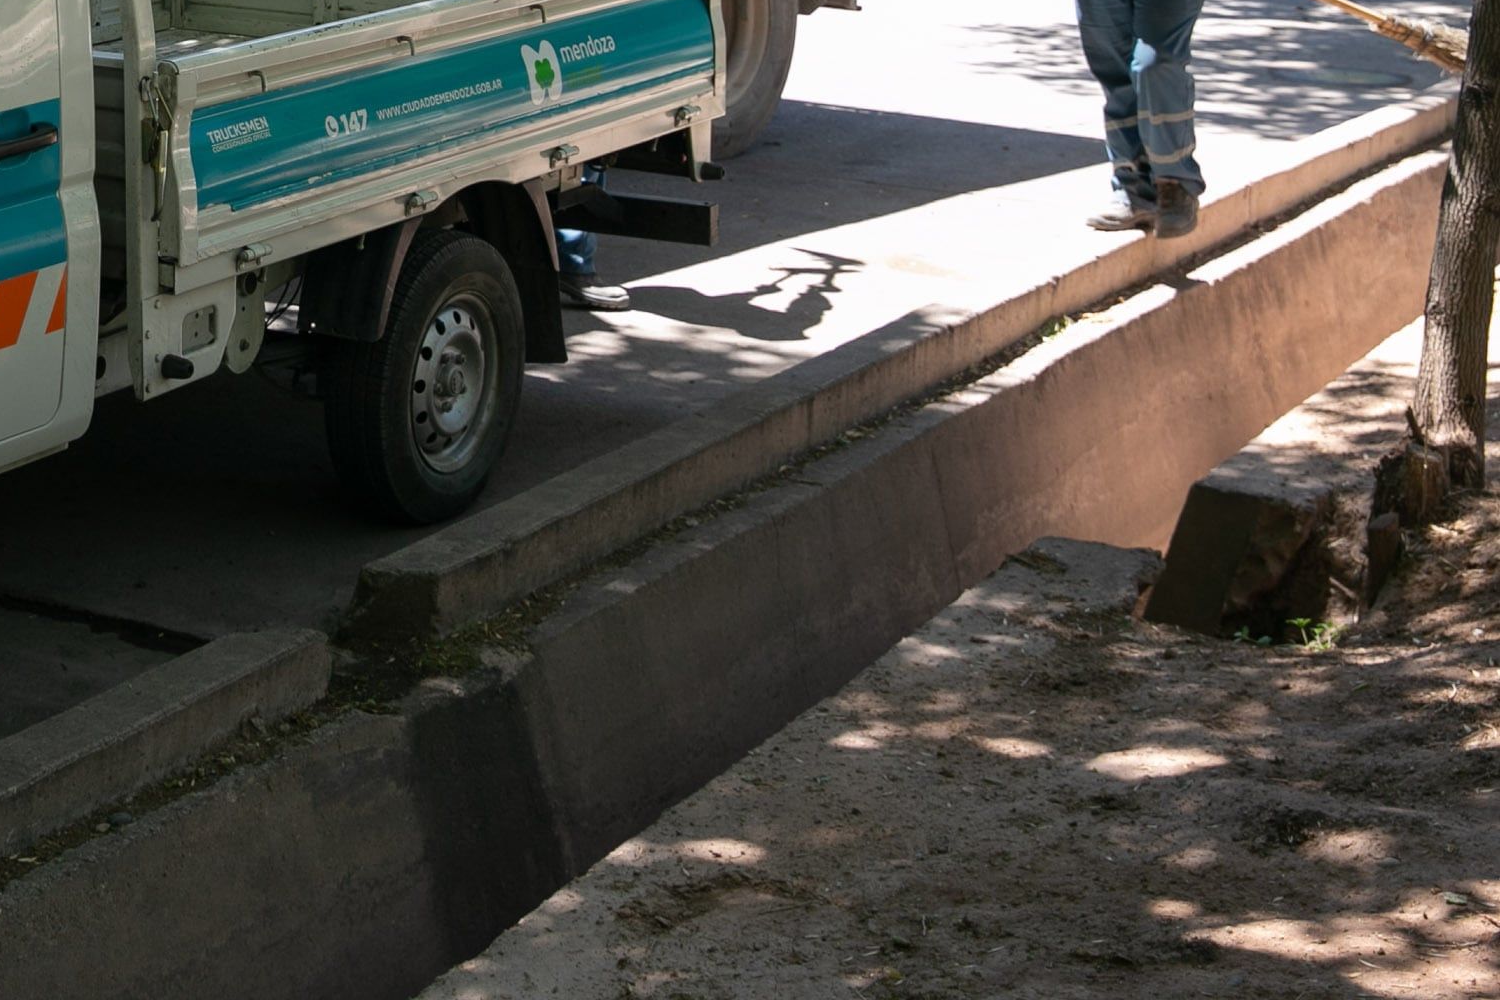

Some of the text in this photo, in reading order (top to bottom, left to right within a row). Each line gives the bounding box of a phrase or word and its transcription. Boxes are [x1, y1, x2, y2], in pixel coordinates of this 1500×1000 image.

[560, 34, 616, 64] mendoza
[376, 79, 502, 120] WWW.CIUDADDEMENDOZA.GOB.AR
[206, 116, 269, 144] TRUCKSMEN
[340, 108, 367, 135] 147
